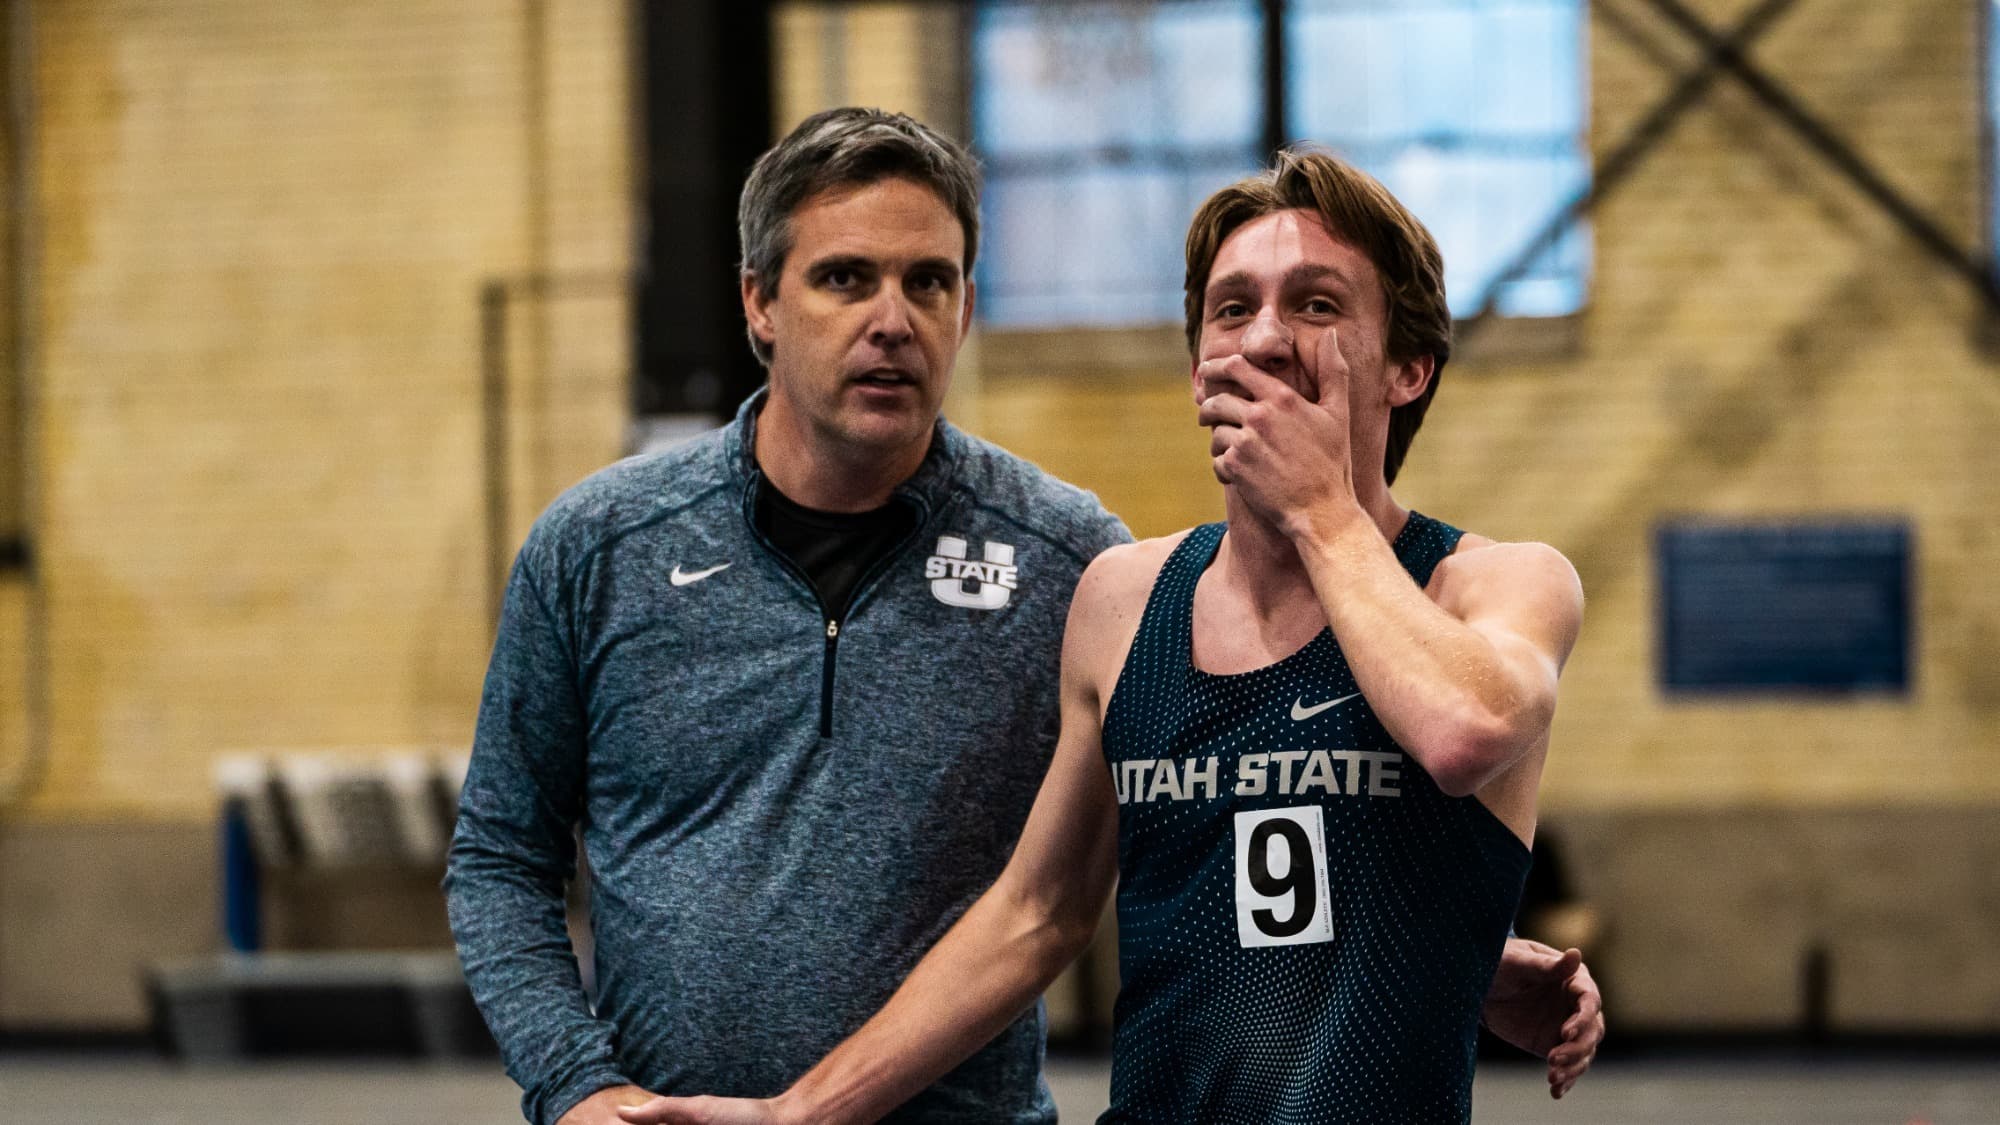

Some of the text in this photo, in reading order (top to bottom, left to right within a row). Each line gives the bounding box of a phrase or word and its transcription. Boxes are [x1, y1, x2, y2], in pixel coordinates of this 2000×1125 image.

[925, 556, 1018, 589] STATE
[931, 536, 1014, 609] U
[1112, 750, 1401, 804] UTAH STATE
[1248, 818, 1316, 937] 9
